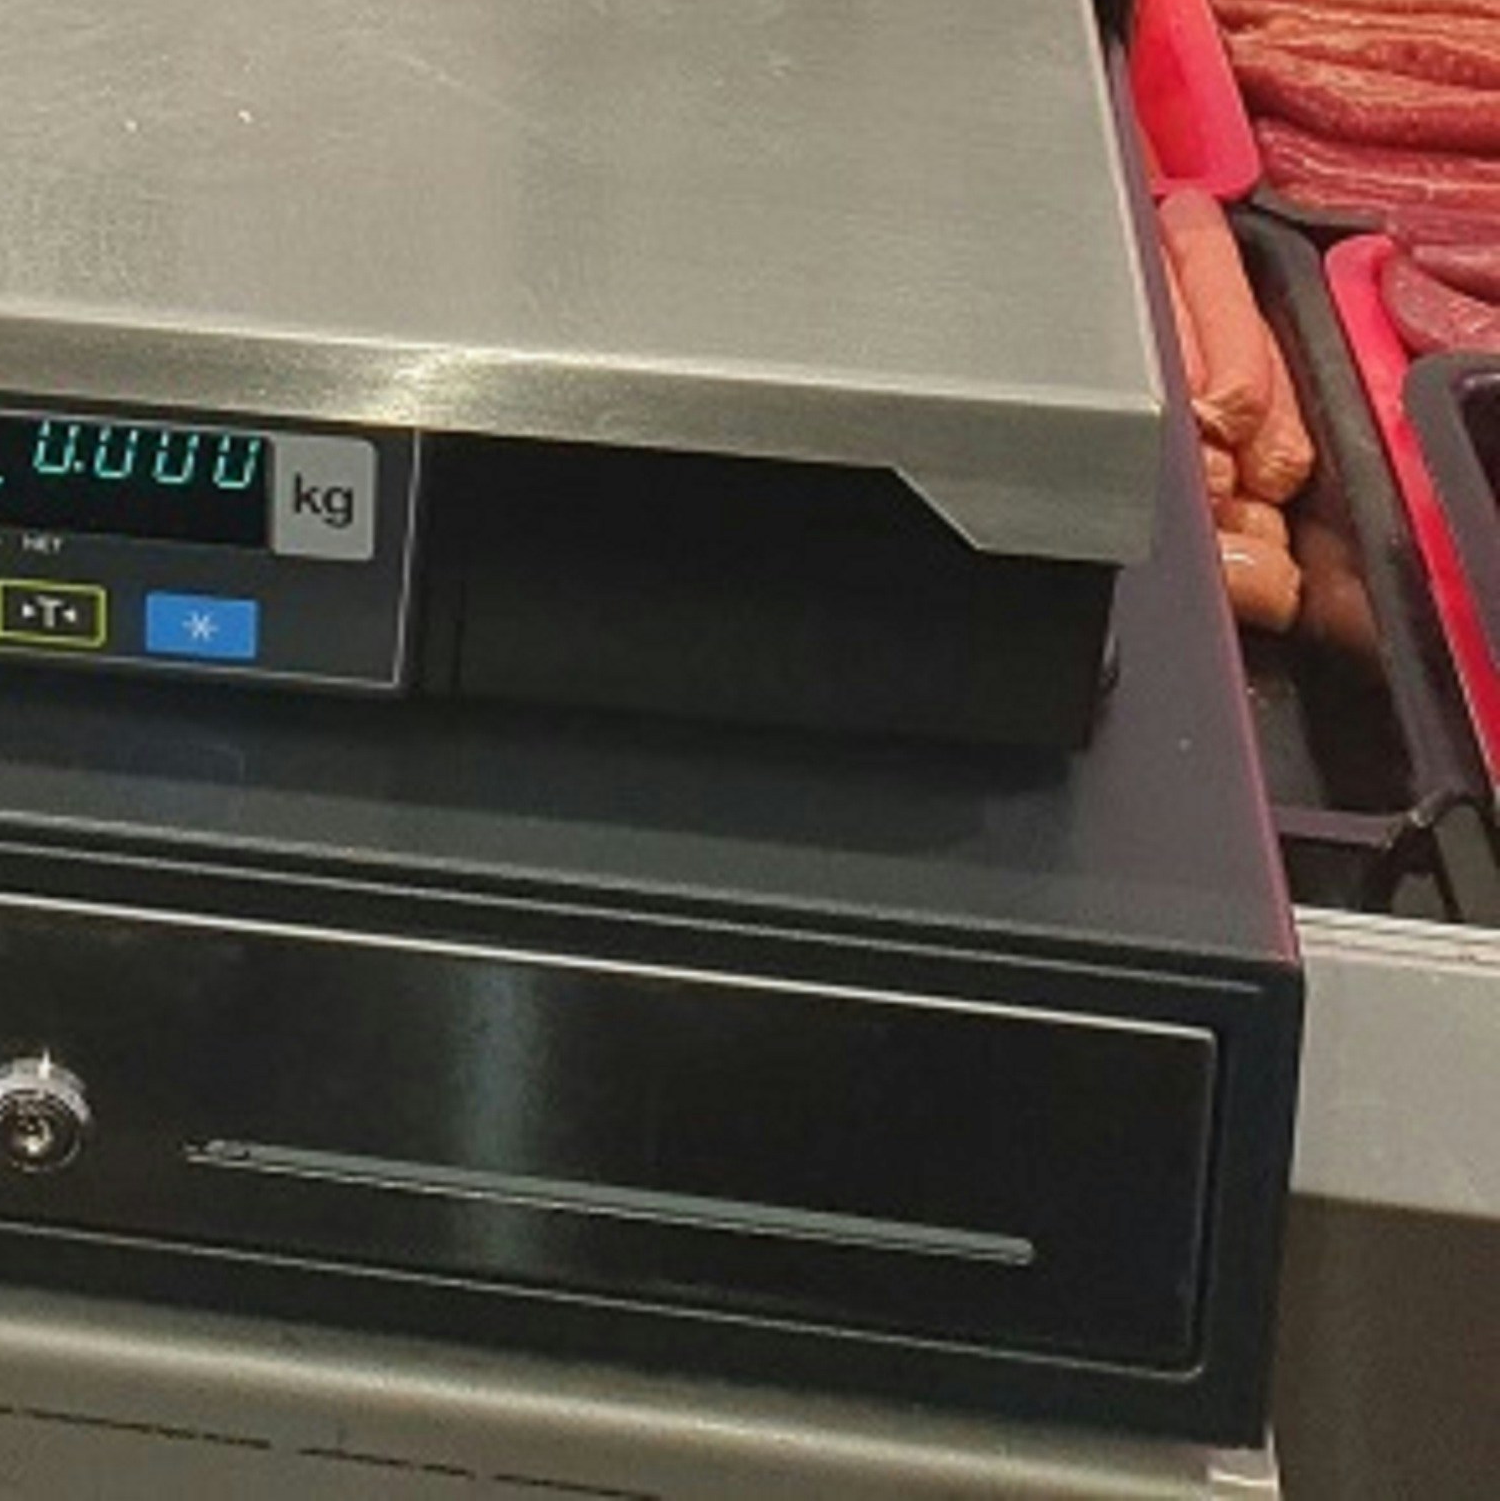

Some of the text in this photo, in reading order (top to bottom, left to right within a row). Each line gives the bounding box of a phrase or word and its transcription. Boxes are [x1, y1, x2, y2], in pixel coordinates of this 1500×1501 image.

[32, 418, 261, 491] 0.000
[291, 475, 355, 525] kg
[35, 593, 65, 629] T
